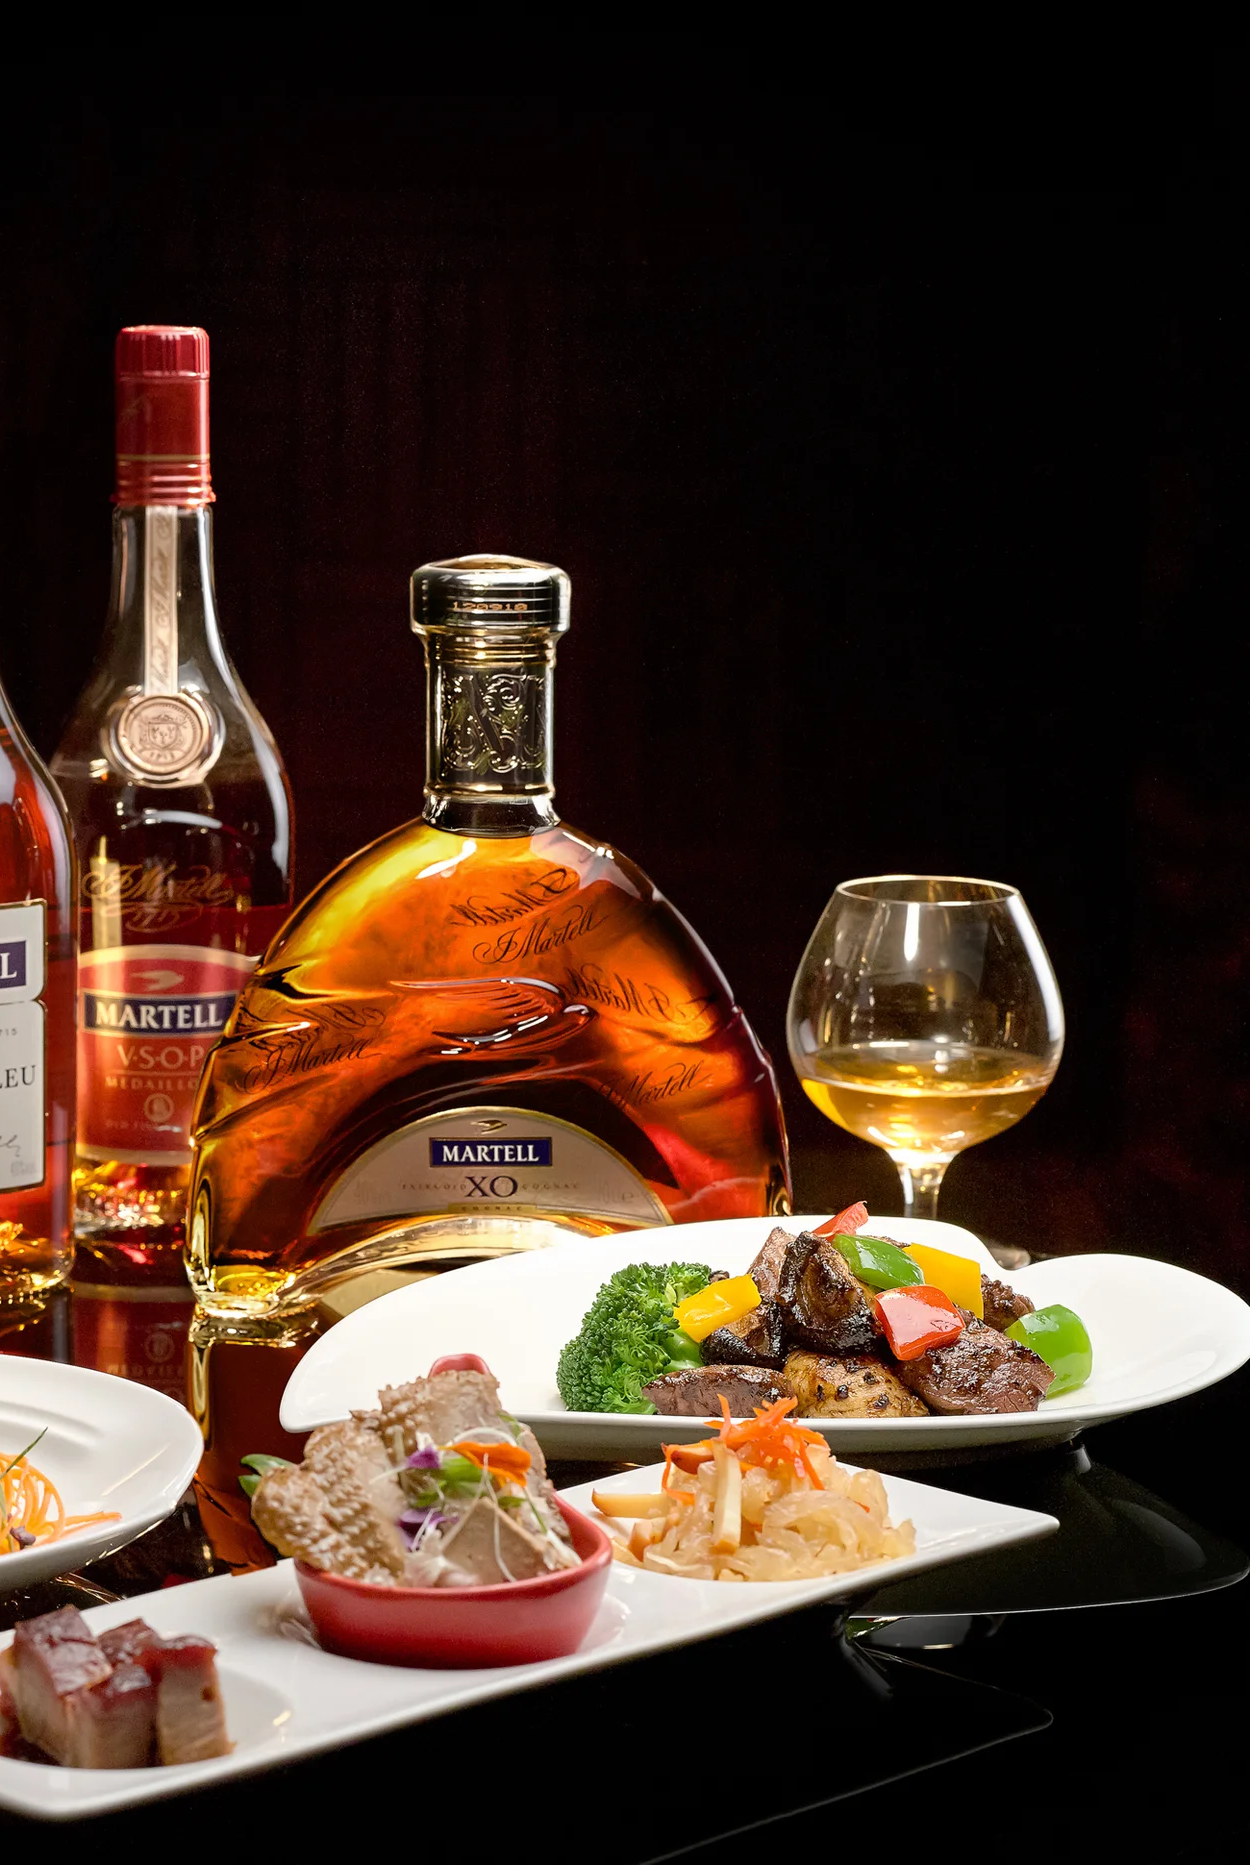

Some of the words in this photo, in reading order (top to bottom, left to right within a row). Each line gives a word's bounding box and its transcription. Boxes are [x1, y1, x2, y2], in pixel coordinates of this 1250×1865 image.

[95, 1001, 223, 1029] MARTELL
[442, 1145, 540, 1163] MARTELL
[464, 1175, 519, 1198] XO
